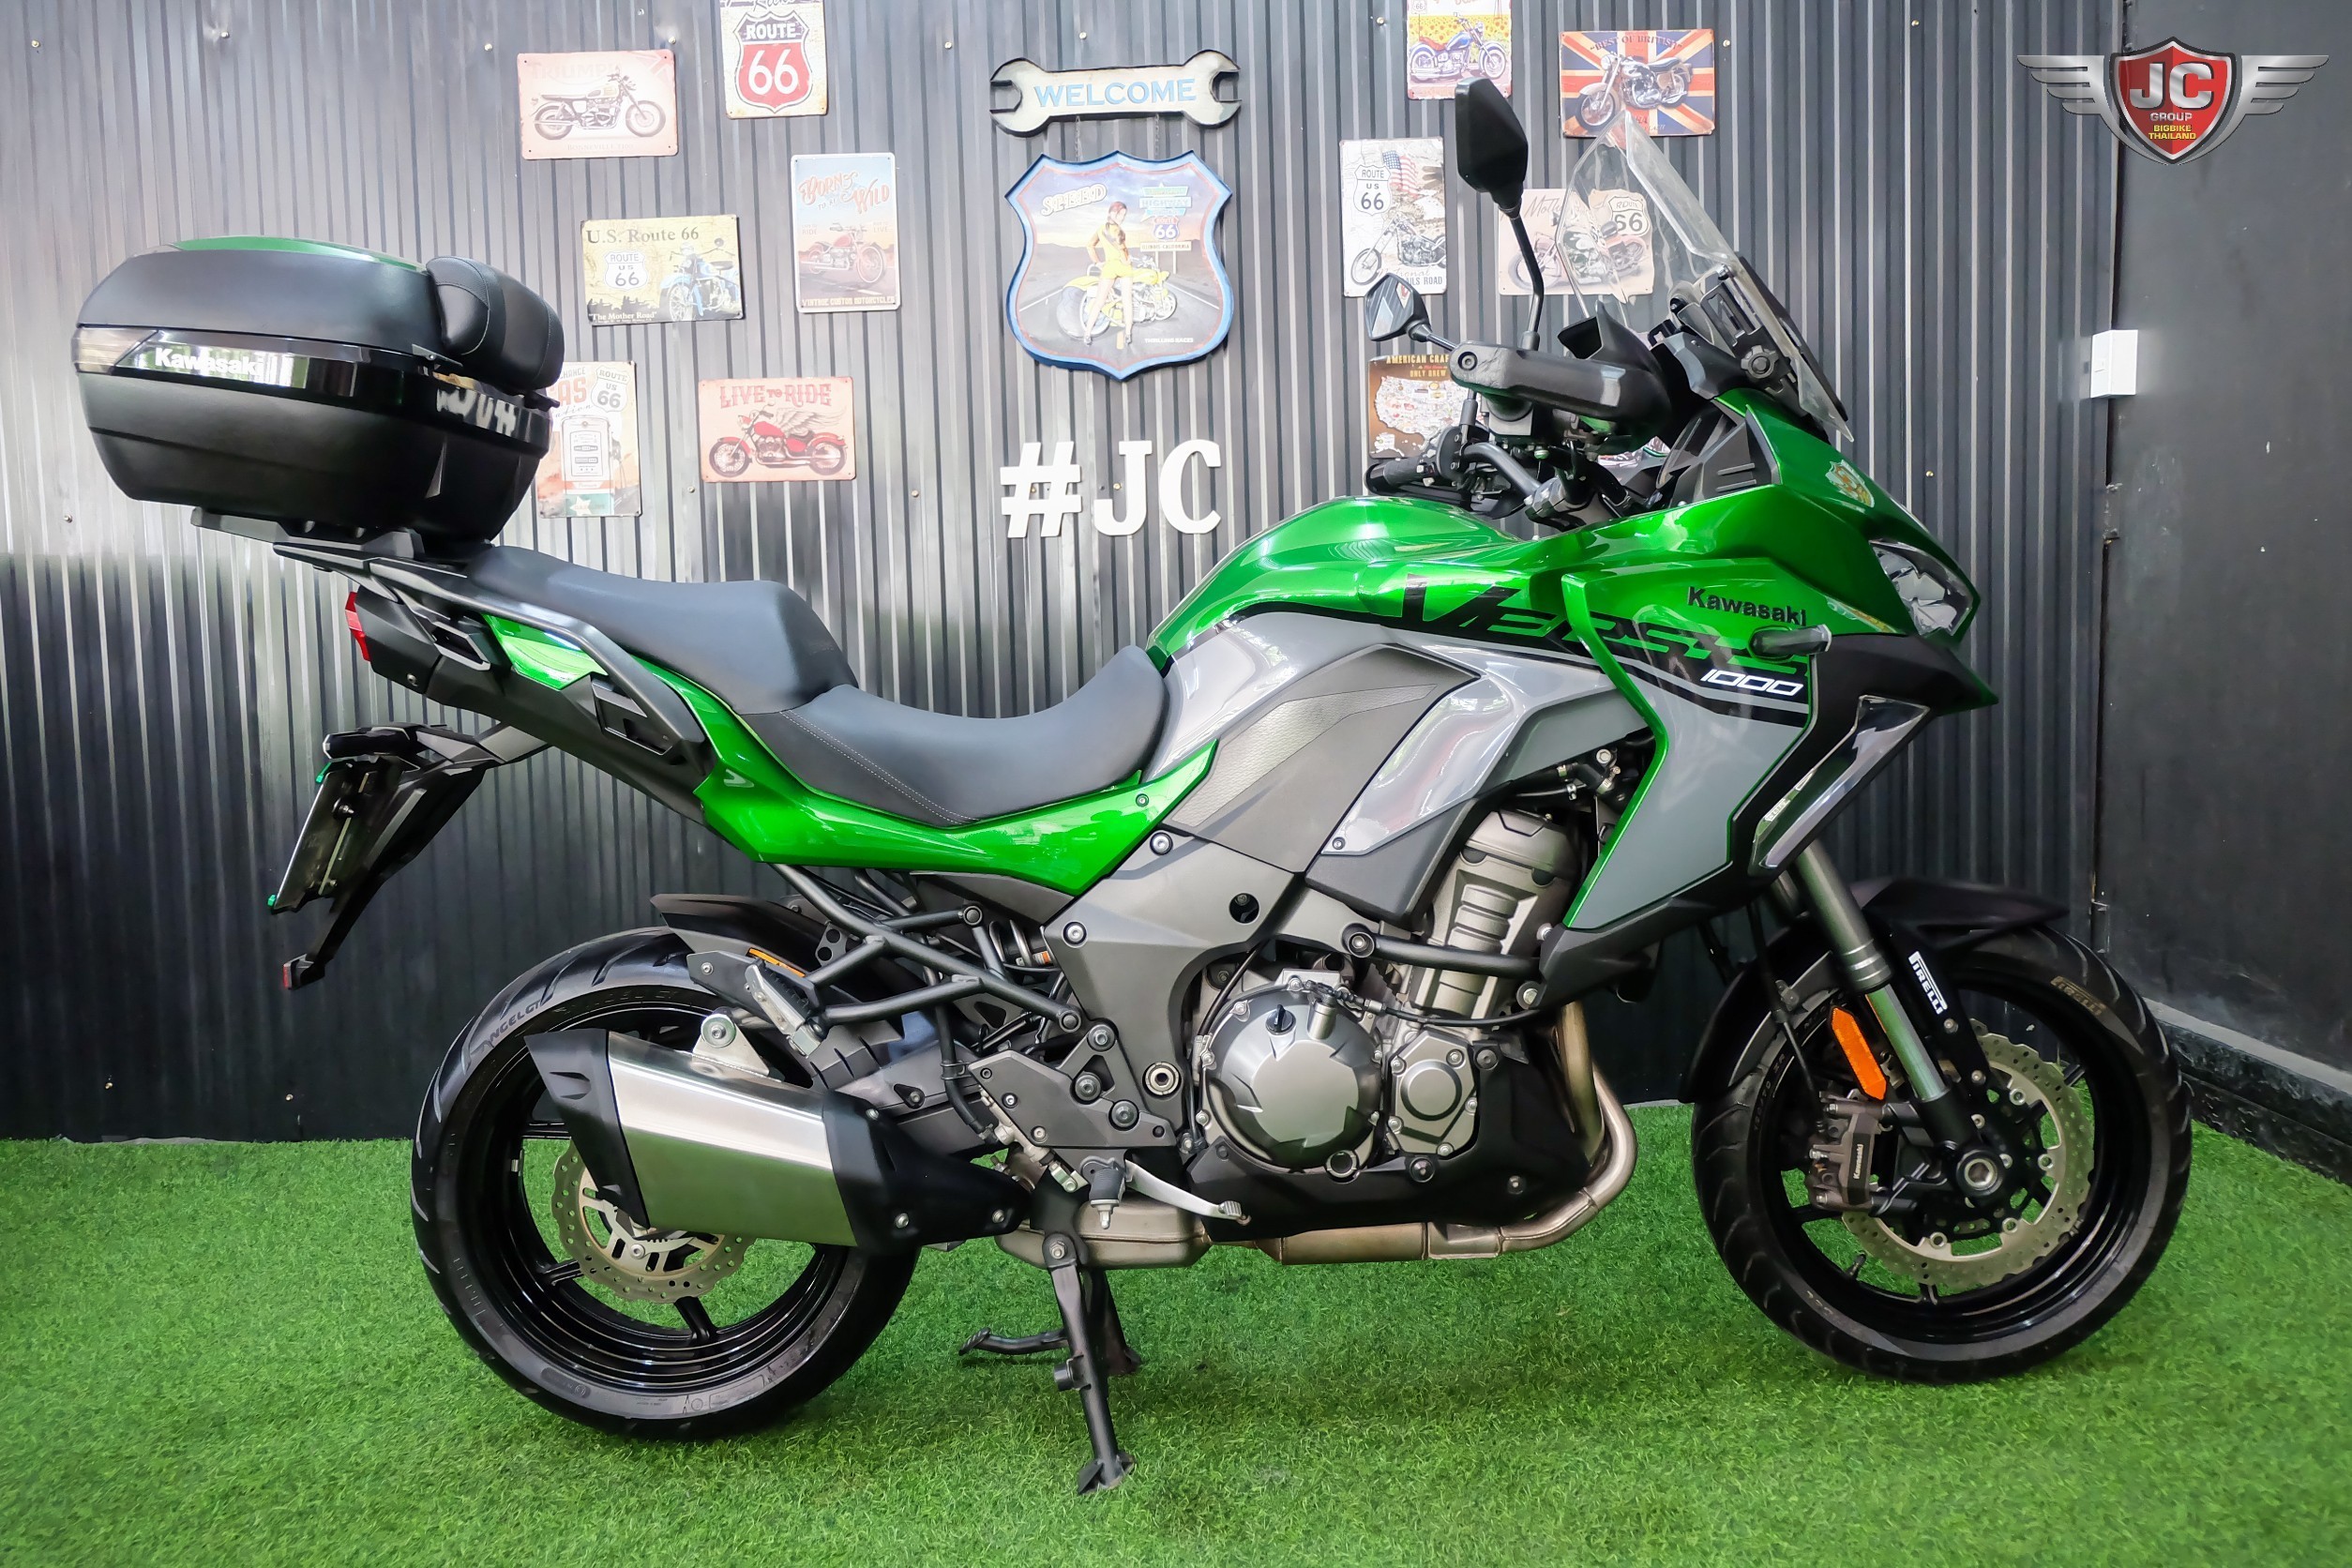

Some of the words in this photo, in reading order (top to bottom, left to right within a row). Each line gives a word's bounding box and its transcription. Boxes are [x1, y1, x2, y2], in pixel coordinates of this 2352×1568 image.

[746, 23, 797, 39] ROUTE
[748, 49, 799, 96] 66
[1033, 78, 1197, 108] WELCOME
[1362, 169, 1384, 178] ROUTE
[798, 173, 852, 205] BORN
[840, 178, 890, 214] WILD
[1141, 199, 1188, 208] HIGHWAY
[1361, 192, 1384, 210] 66
[586, 229, 621, 244] U.S.
[628, 228, 676, 244] Route
[681, 227, 700, 241] 66
[1155, 225, 1177, 239] 66
[610, 253, 640, 263] ROUTE
[615, 272, 640, 287] 66
[1424, 276, 1442, 285] ROAD
[155, 347, 264, 375] Kawasaki
[1386, 354, 1426, 364] AMERICAN
[1429, 354, 1450, 364] CRAF
[561, 368, 586, 379] HANCE
[599, 369, 628, 382] ROUTE
[606, 383, 617, 391] US
[720, 385, 765, 409] LIVE
[766, 388, 782, 398] TO
[784, 383, 832, 407] RIDE
[596, 390, 622, 409] 66
[1687, 586, 1807, 626] Kawasaki
[1699, 669, 1804, 697] 1000
[1907, 950, 1948, 1015] PIRELLI
[2050, 975, 2107, 1017] PIRELLI
[1853, 1144, 1864, 1180] Kawasaki
